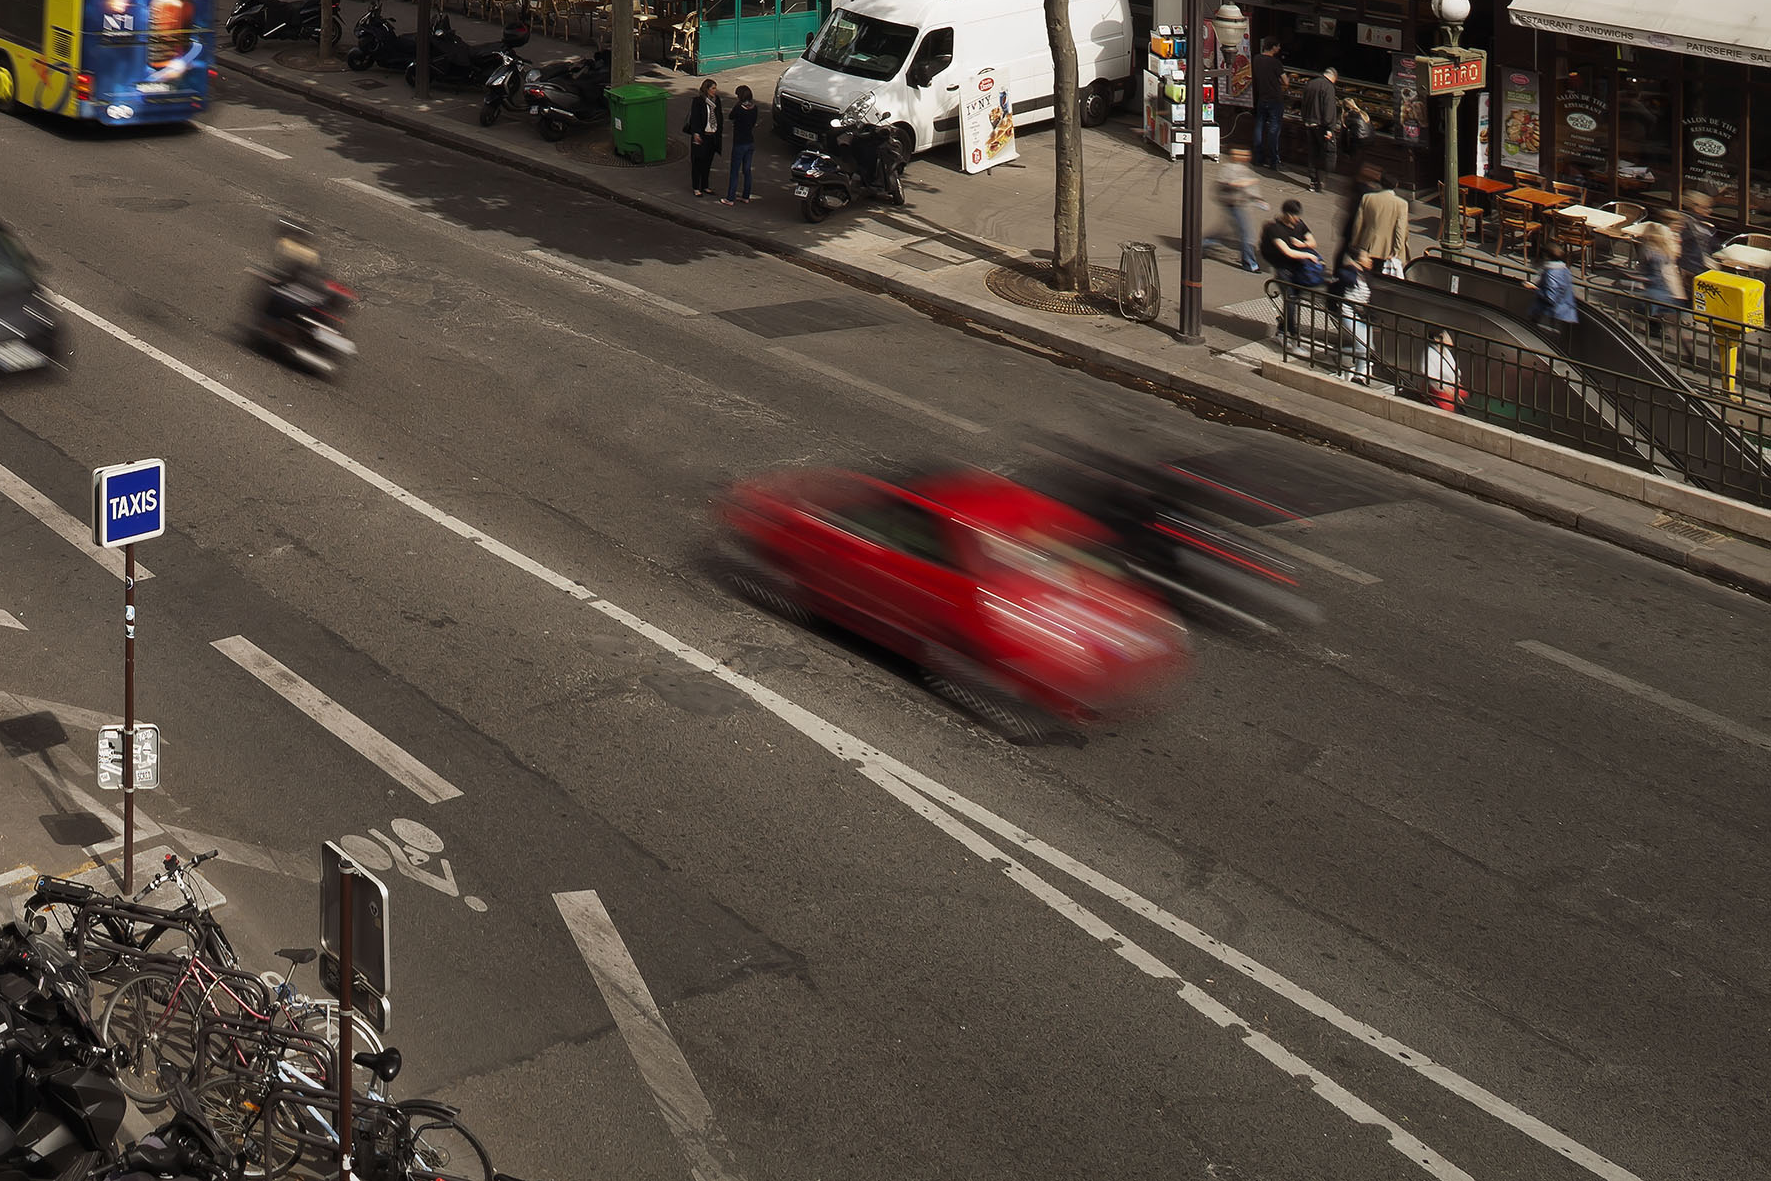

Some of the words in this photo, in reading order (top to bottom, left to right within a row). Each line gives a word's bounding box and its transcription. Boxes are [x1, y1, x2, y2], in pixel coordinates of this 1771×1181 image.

[1515, 13, 1573, 30] RESTAURANT
[1578, 24, 1634, 41] SANDWICHS
[1686, 42, 1742, 59] PATISSERIE
[1750, 52, 1771, 63] SAL
[109, 488, 158, 521] TAXIS
